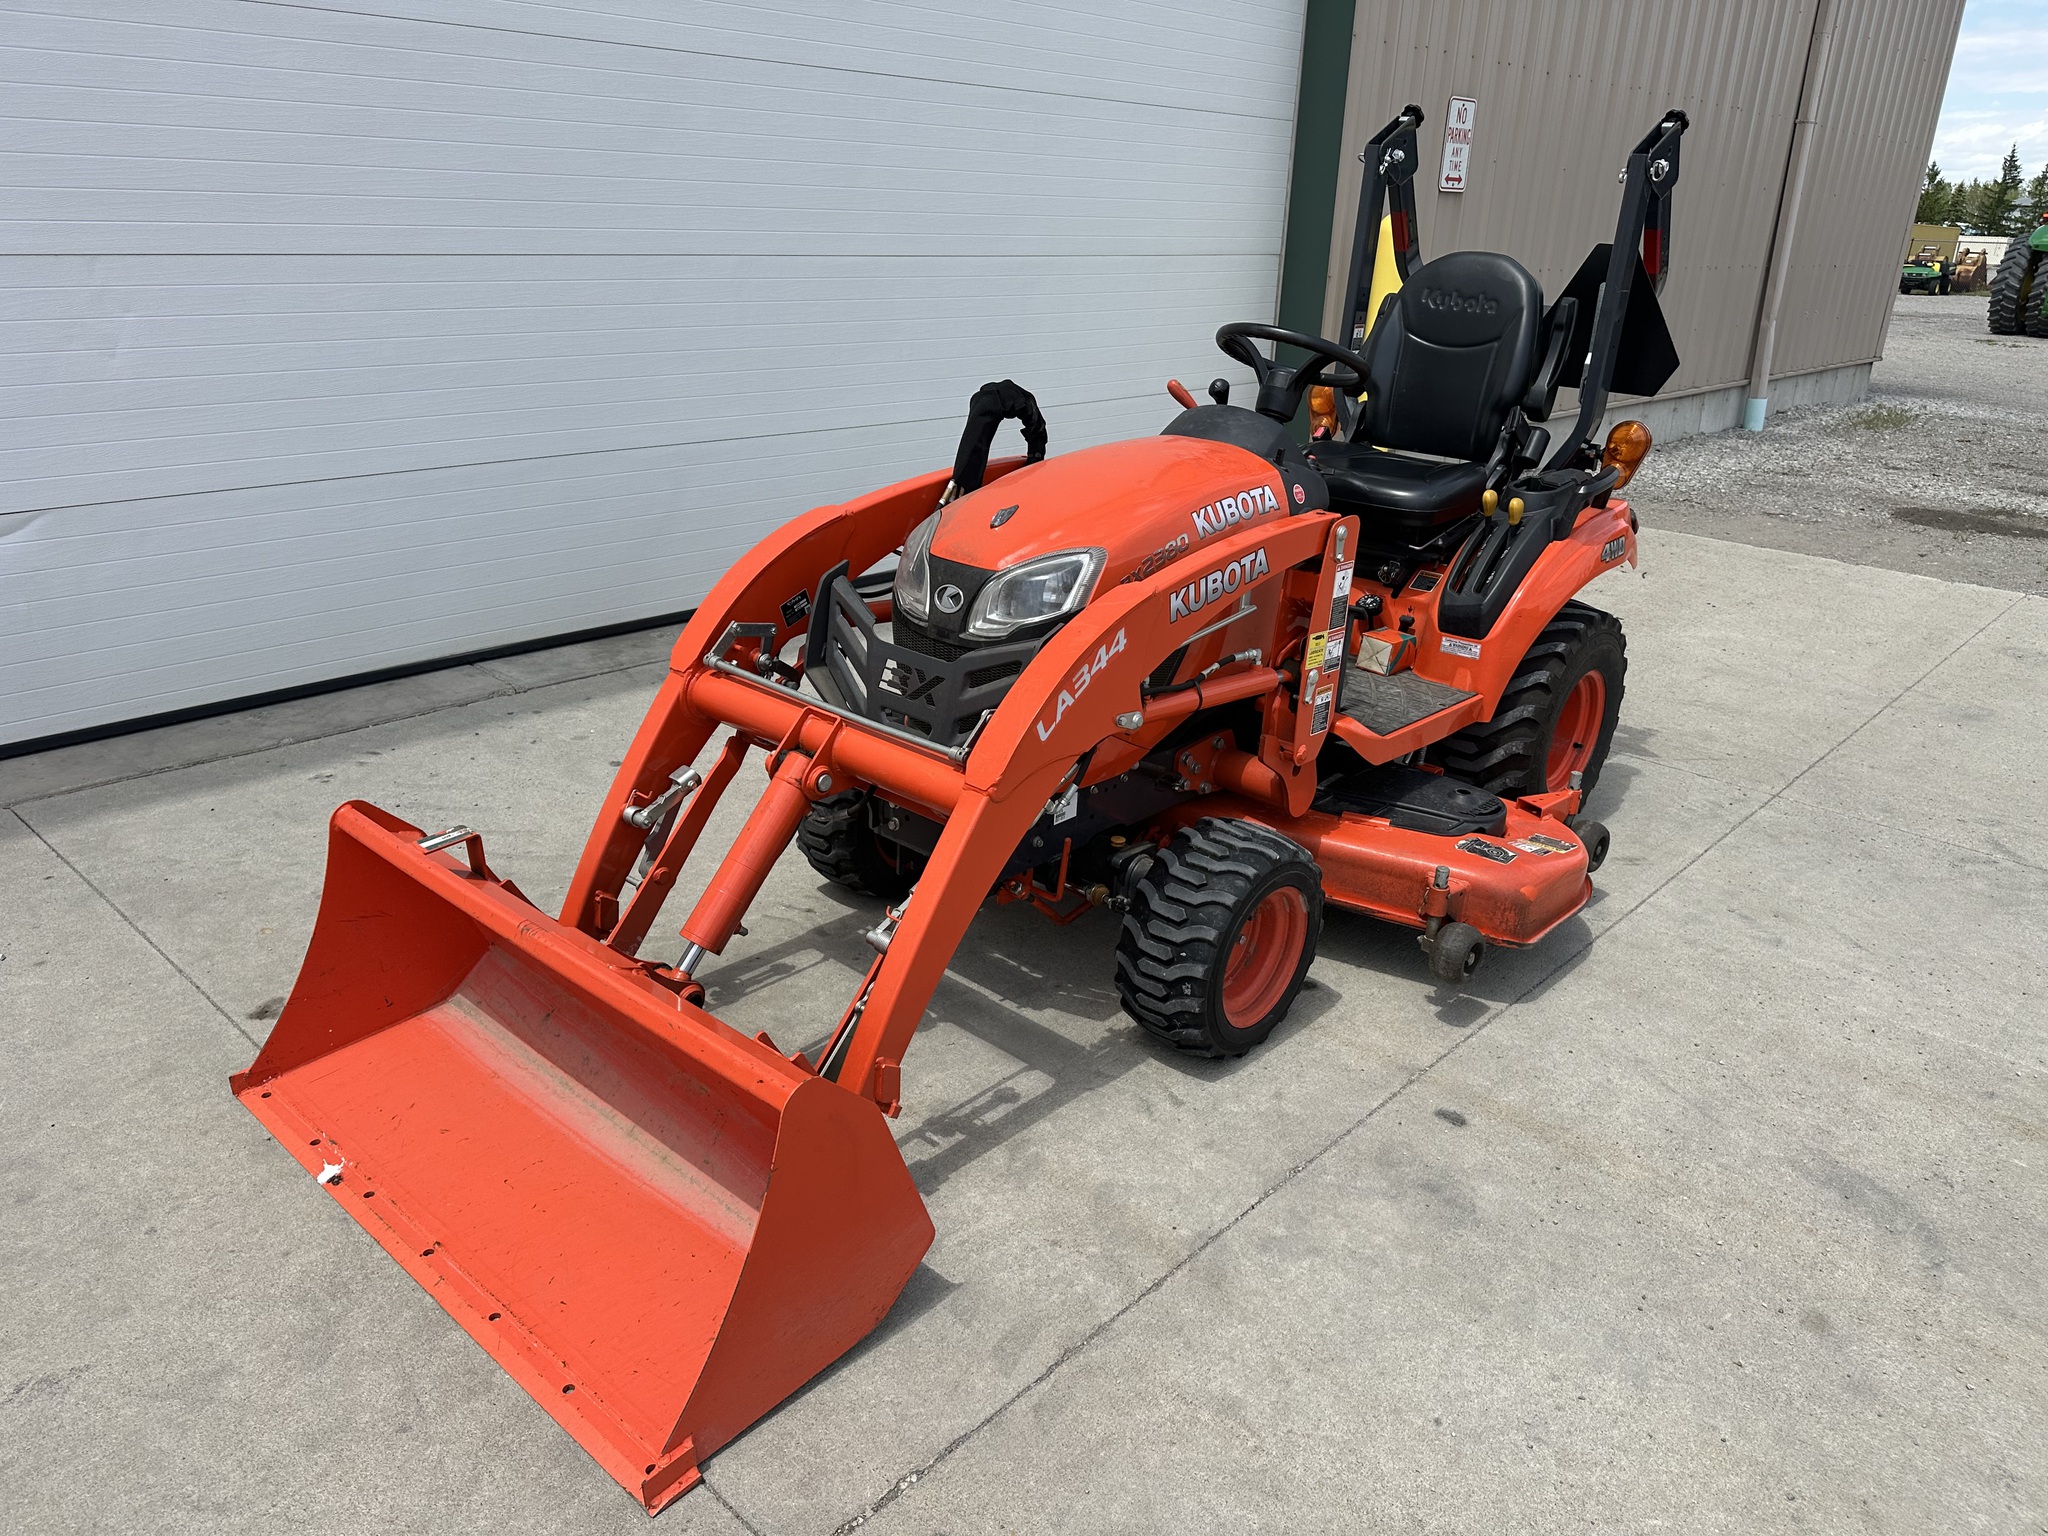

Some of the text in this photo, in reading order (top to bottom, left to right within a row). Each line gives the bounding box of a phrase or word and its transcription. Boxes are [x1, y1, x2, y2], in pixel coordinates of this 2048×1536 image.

[1456, 107, 1468, 124] NO
[1447, 127, 1471, 145] PARKING
[1449, 160, 1462, 172] TIME
[1451, 147, 1463, 158] ANY
[1421, 287, 1499, 314] Kubota
[1191, 484, 1280, 540] KUBOTA
[1601, 535, 1626, 563] 4WD
[1169, 546, 1270, 624] KUBOTA
[878, 658, 946, 709] BX
[1036, 627, 1128, 742] LA344
